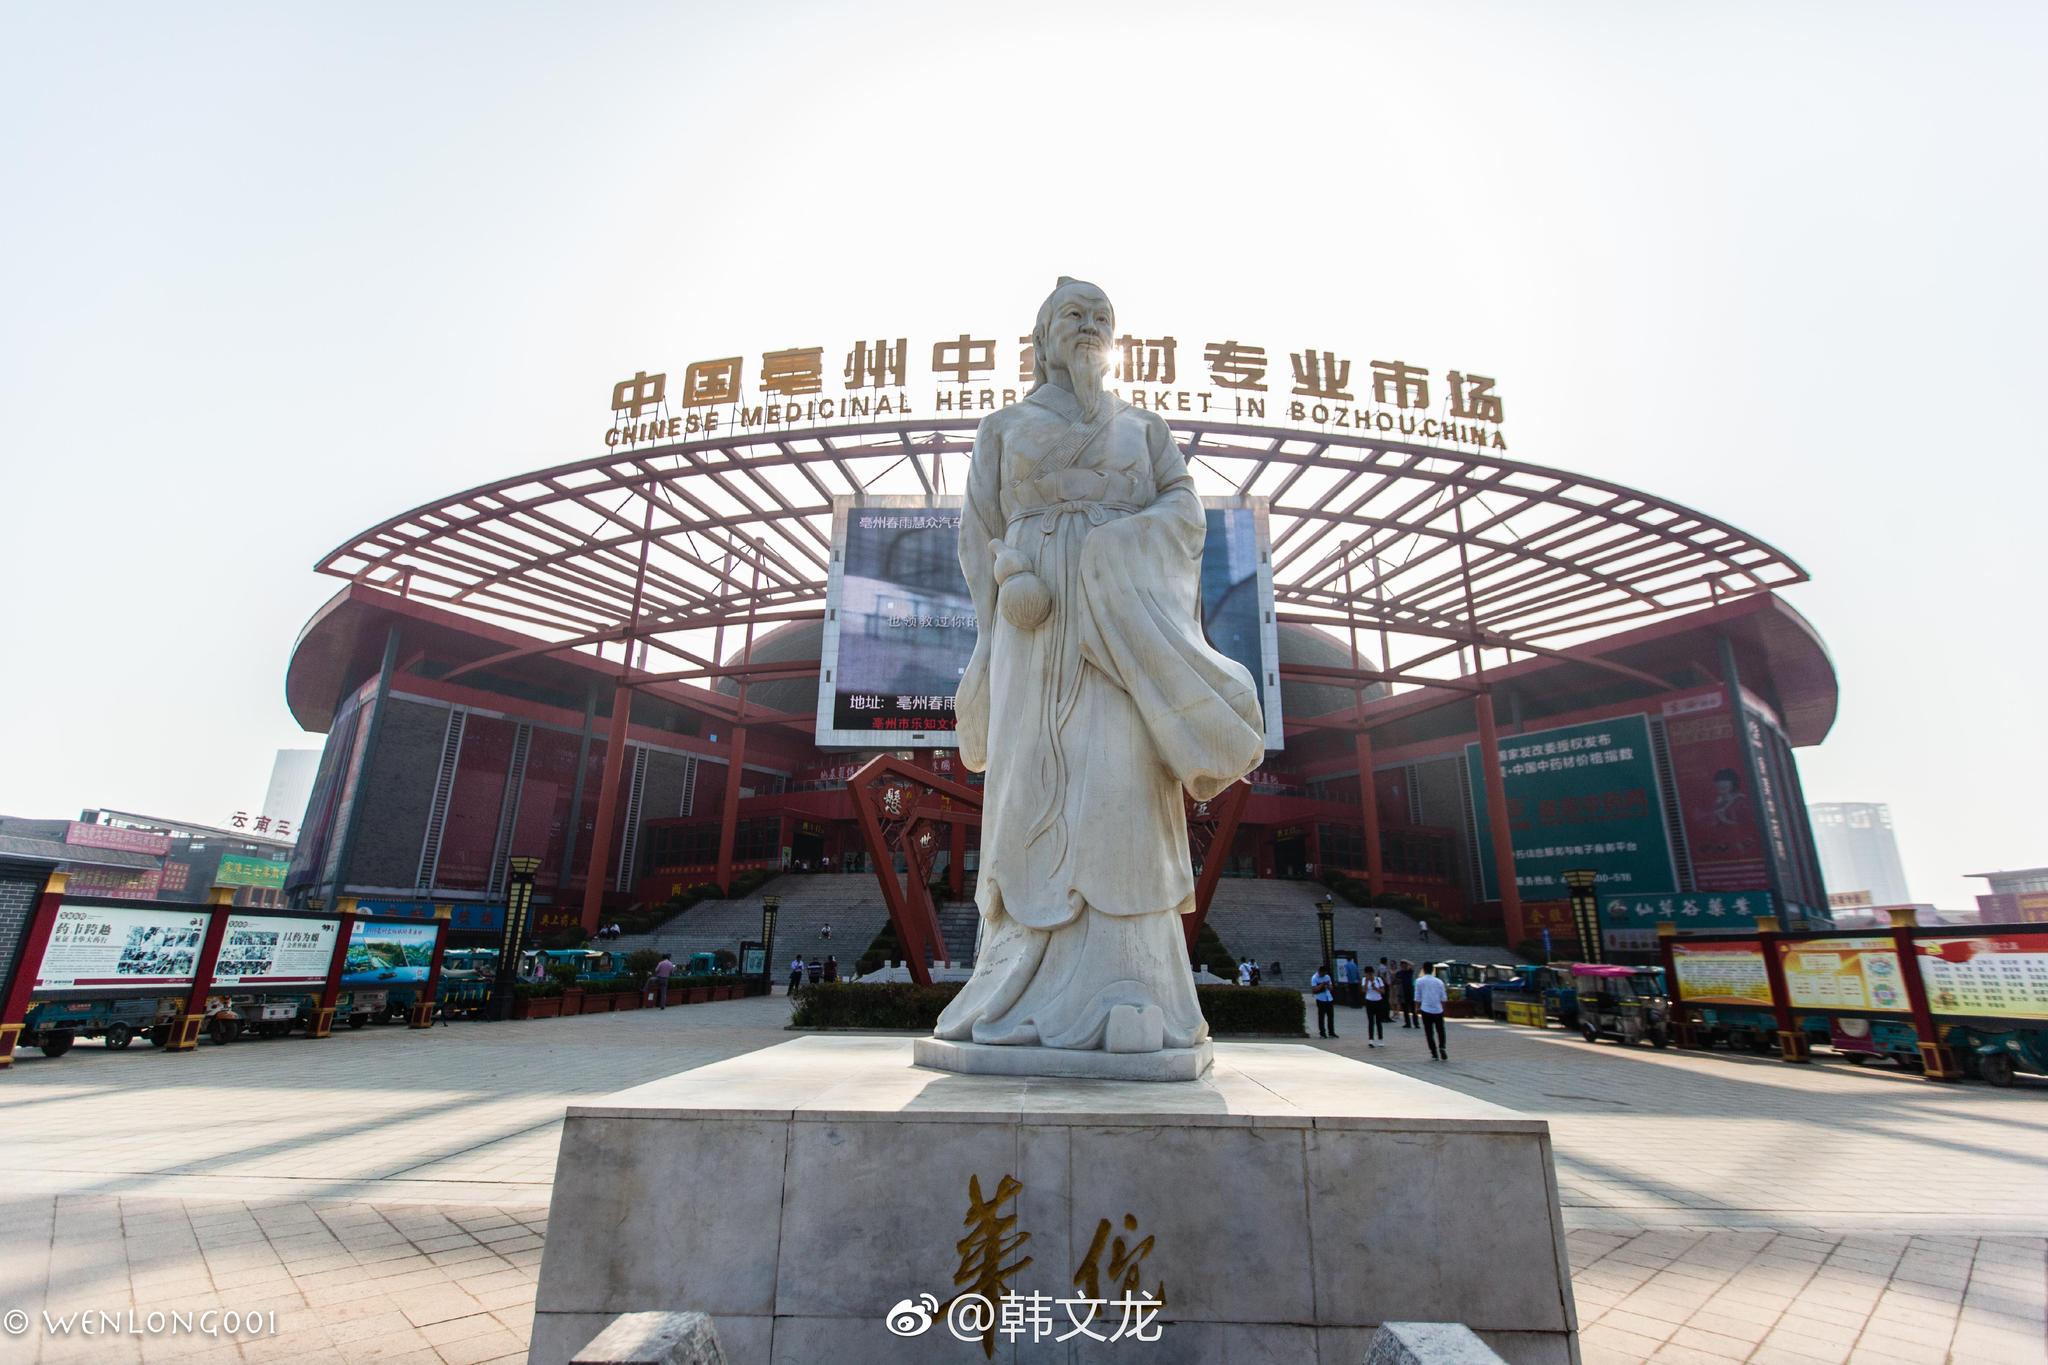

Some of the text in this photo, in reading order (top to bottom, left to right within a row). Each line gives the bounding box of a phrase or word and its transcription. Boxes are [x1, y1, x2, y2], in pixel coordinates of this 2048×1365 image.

[605, 412, 720, 447] CHINESE
[741, 393, 912, 427] MEDICINAL
[1236, 397, 1265, 418] IN
[232, 811, 301, 836] 云南三
[1511, 841, 1638, 859] 药信息服务与电子商务平台
